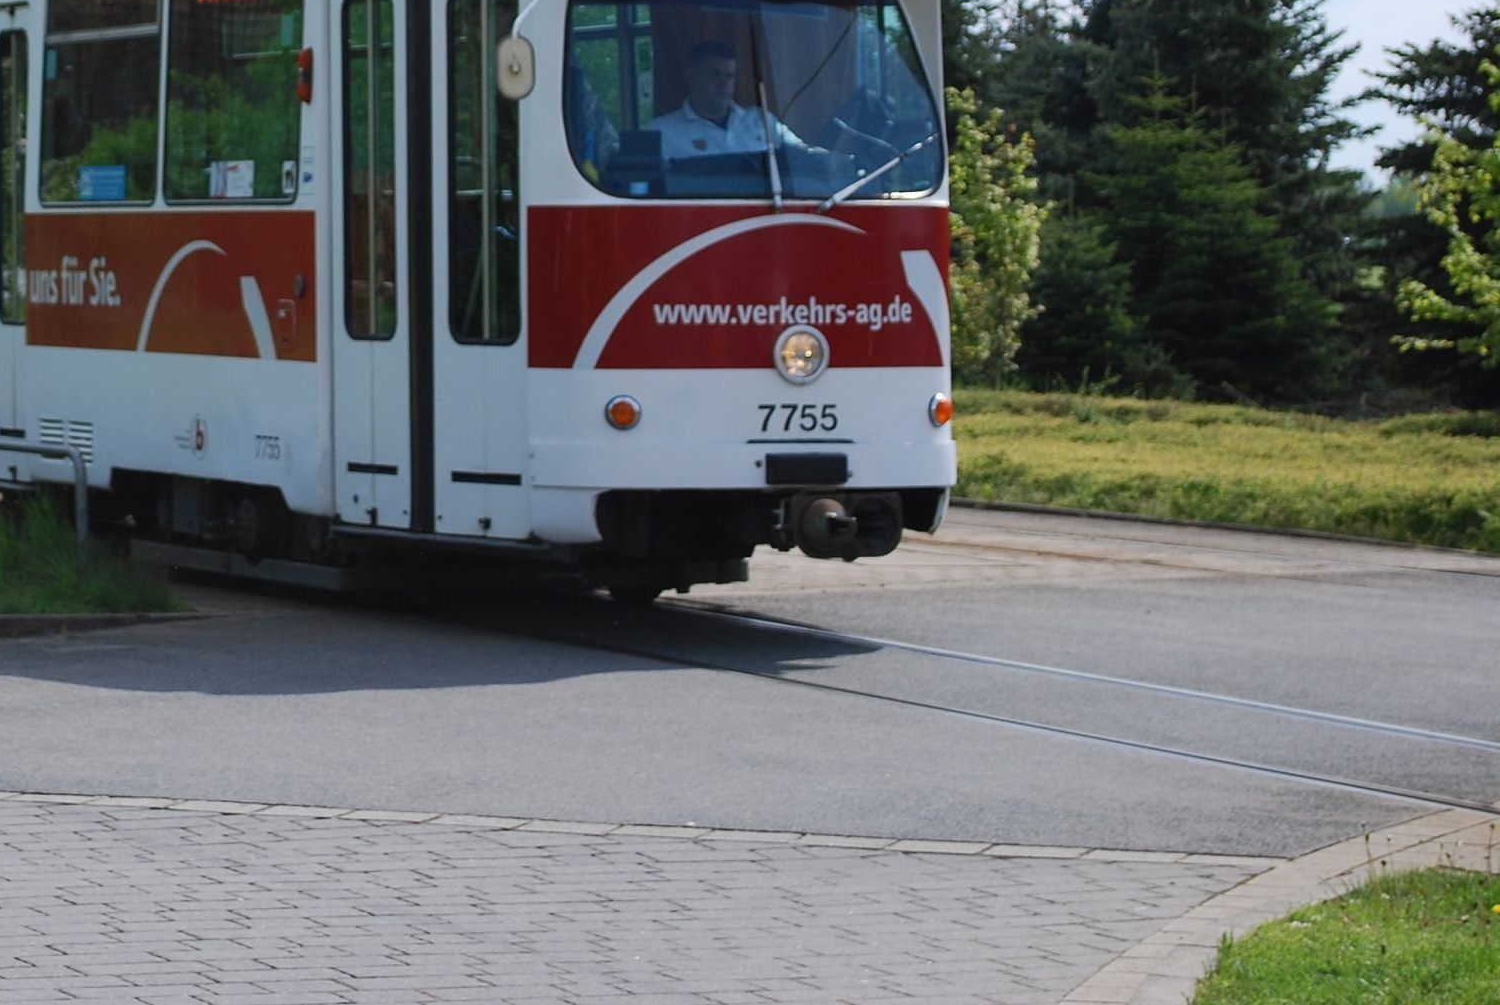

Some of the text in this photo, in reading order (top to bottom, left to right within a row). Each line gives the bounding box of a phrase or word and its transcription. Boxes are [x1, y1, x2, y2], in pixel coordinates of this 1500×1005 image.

[29, 269, 59, 305] uns
[653, 295, 912, 331] www.verkehrs-ag.de
[757, 404, 838, 432] 7755
